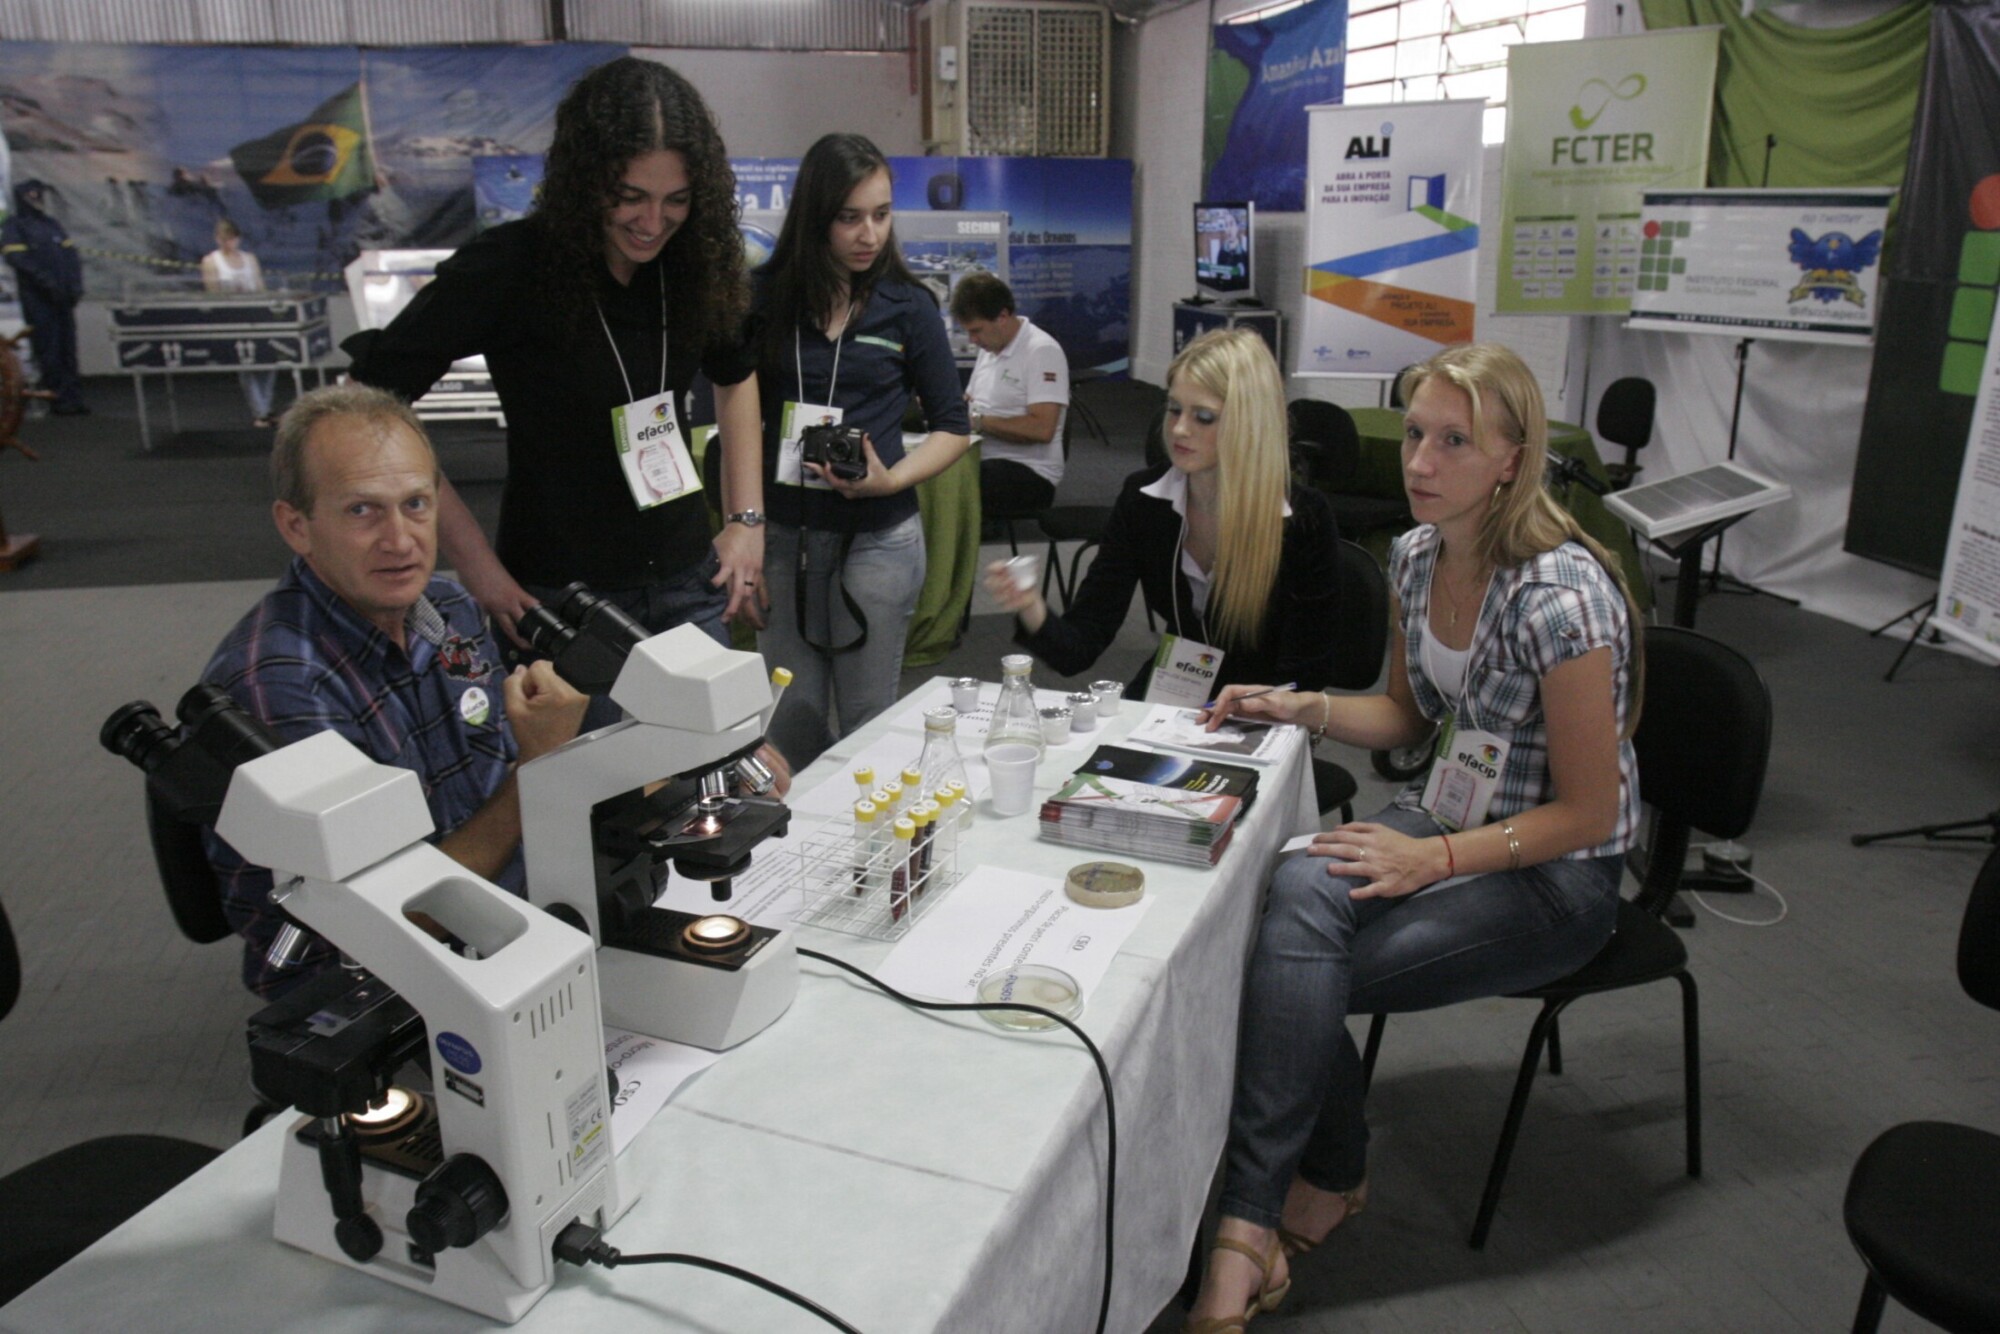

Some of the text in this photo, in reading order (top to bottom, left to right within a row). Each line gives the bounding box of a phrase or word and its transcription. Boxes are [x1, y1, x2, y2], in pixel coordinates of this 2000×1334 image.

[1309, 39, 1345, 70] Azul
[1552, 132, 1655, 166] FCTER
[1335, 172, 1356, 181] ABRA
[1366, 170, 1391, 180] PORTA
[1324, 181, 1391, 193] DA SUA EMPRESA
[1321, 195, 1341, 204] PARA
[1350, 192, 1391, 204] INOVAÇÃO
[957, 221, 1001, 234] SECIRM
[1686, 275, 1779, 288] INSTITUTO FEDERAL
[1685, 285, 1757, 297] SANTA CATARINA
[637, 420, 675, 442] efacip
[1176, 661, 1214, 679] efacip
[1458, 750, 1498, 779] efacip
[982, 933, 1013, 967] presentes
[974, 967, 987, 979] no
